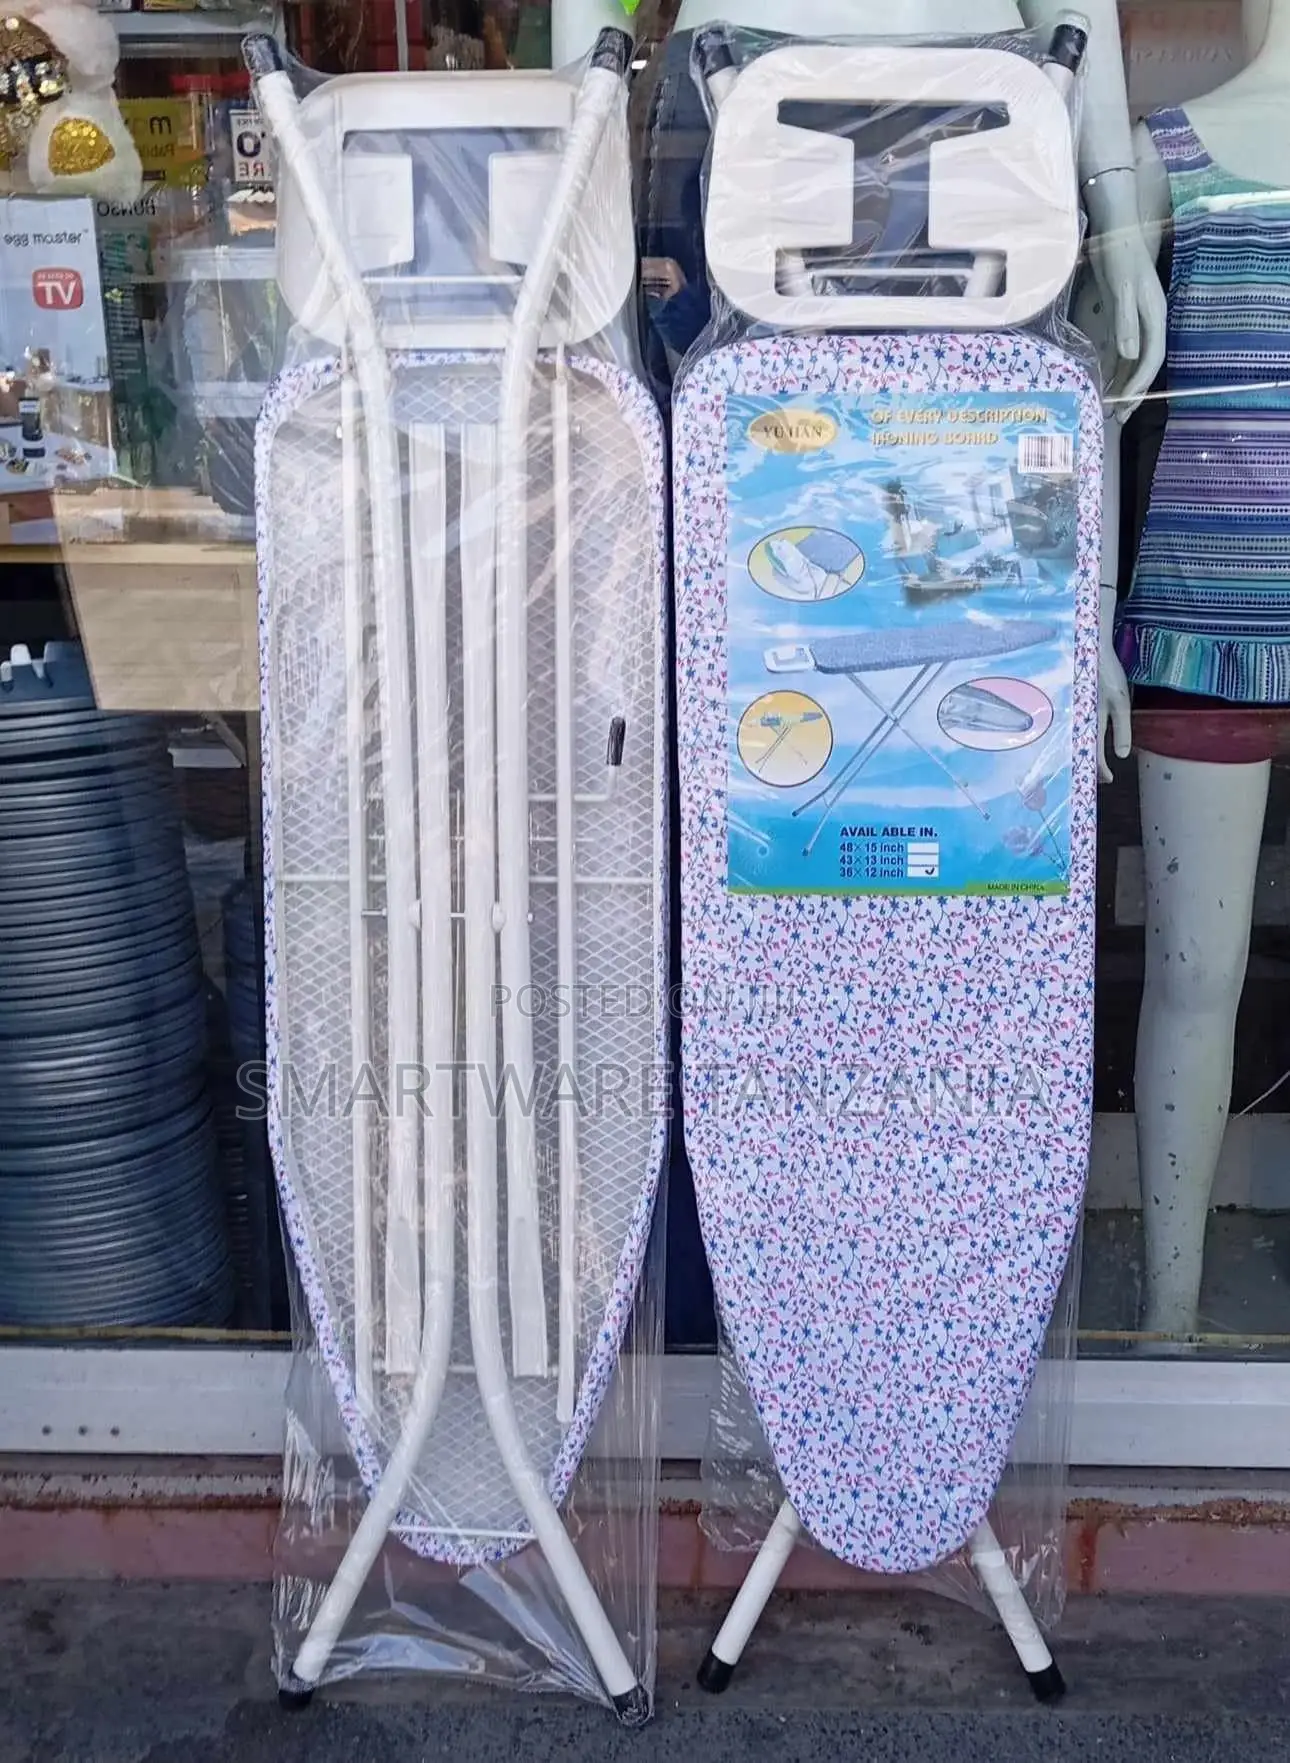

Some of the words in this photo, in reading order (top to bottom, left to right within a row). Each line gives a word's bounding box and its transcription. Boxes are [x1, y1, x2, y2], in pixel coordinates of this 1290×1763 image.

[4, 233, 29, 247] egg
[33, 231, 82, 245] master
[37, 280, 77, 305] TV
[948, 408, 1049, 425] DESCRIPTION
[840, 826, 878, 837] AVAIL
[882, 826, 916, 837] ABLE
[919, 826, 938, 837] IN.
[880, 842, 904, 853] inch
[880, 854, 904, 865] inch
[880, 866, 904, 878] inch
